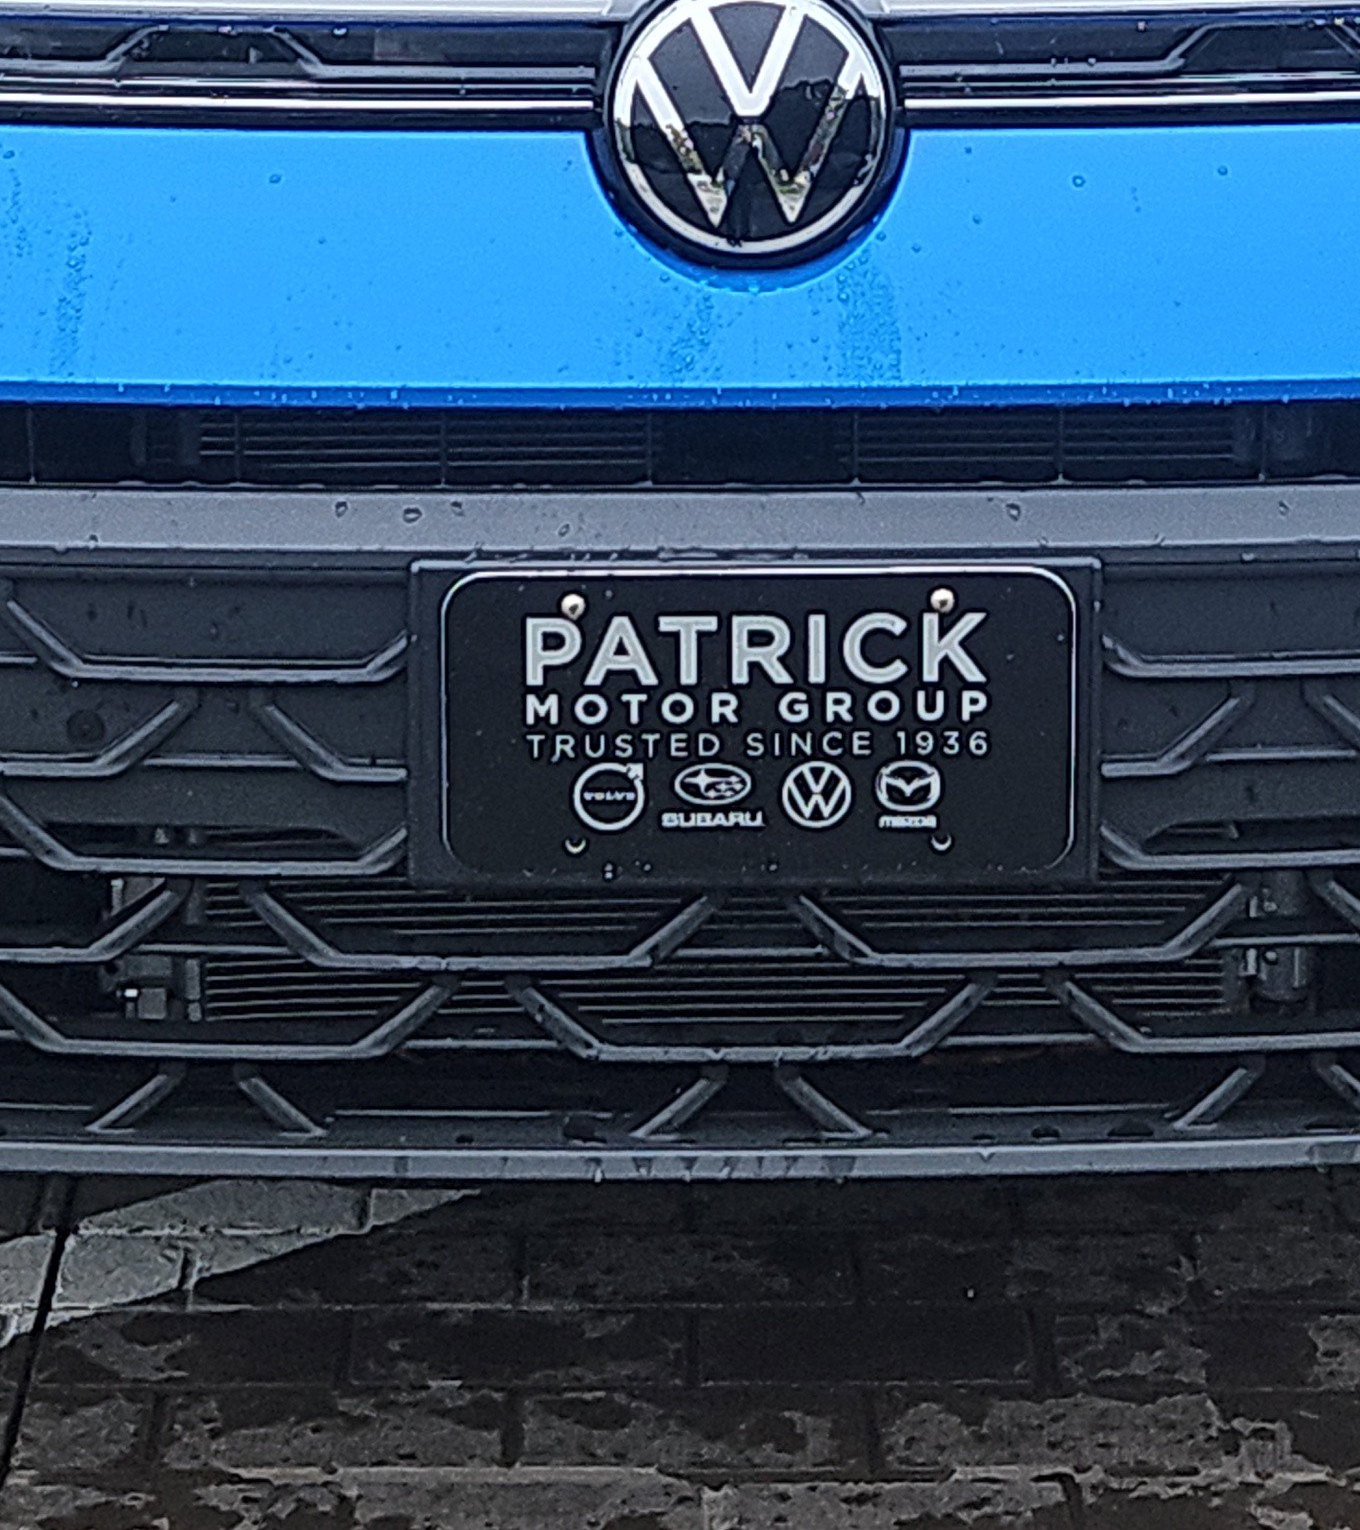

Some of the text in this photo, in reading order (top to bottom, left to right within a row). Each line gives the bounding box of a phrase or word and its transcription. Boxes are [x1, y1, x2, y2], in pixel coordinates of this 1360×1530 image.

[525, 611, 987, 686] PATRICK
[525, 689, 987, 726] MOTOR GROUP
[526, 730, 987, 760] TRUSTED SINCE 1936
[660, 810, 766, 828] SUBARU
